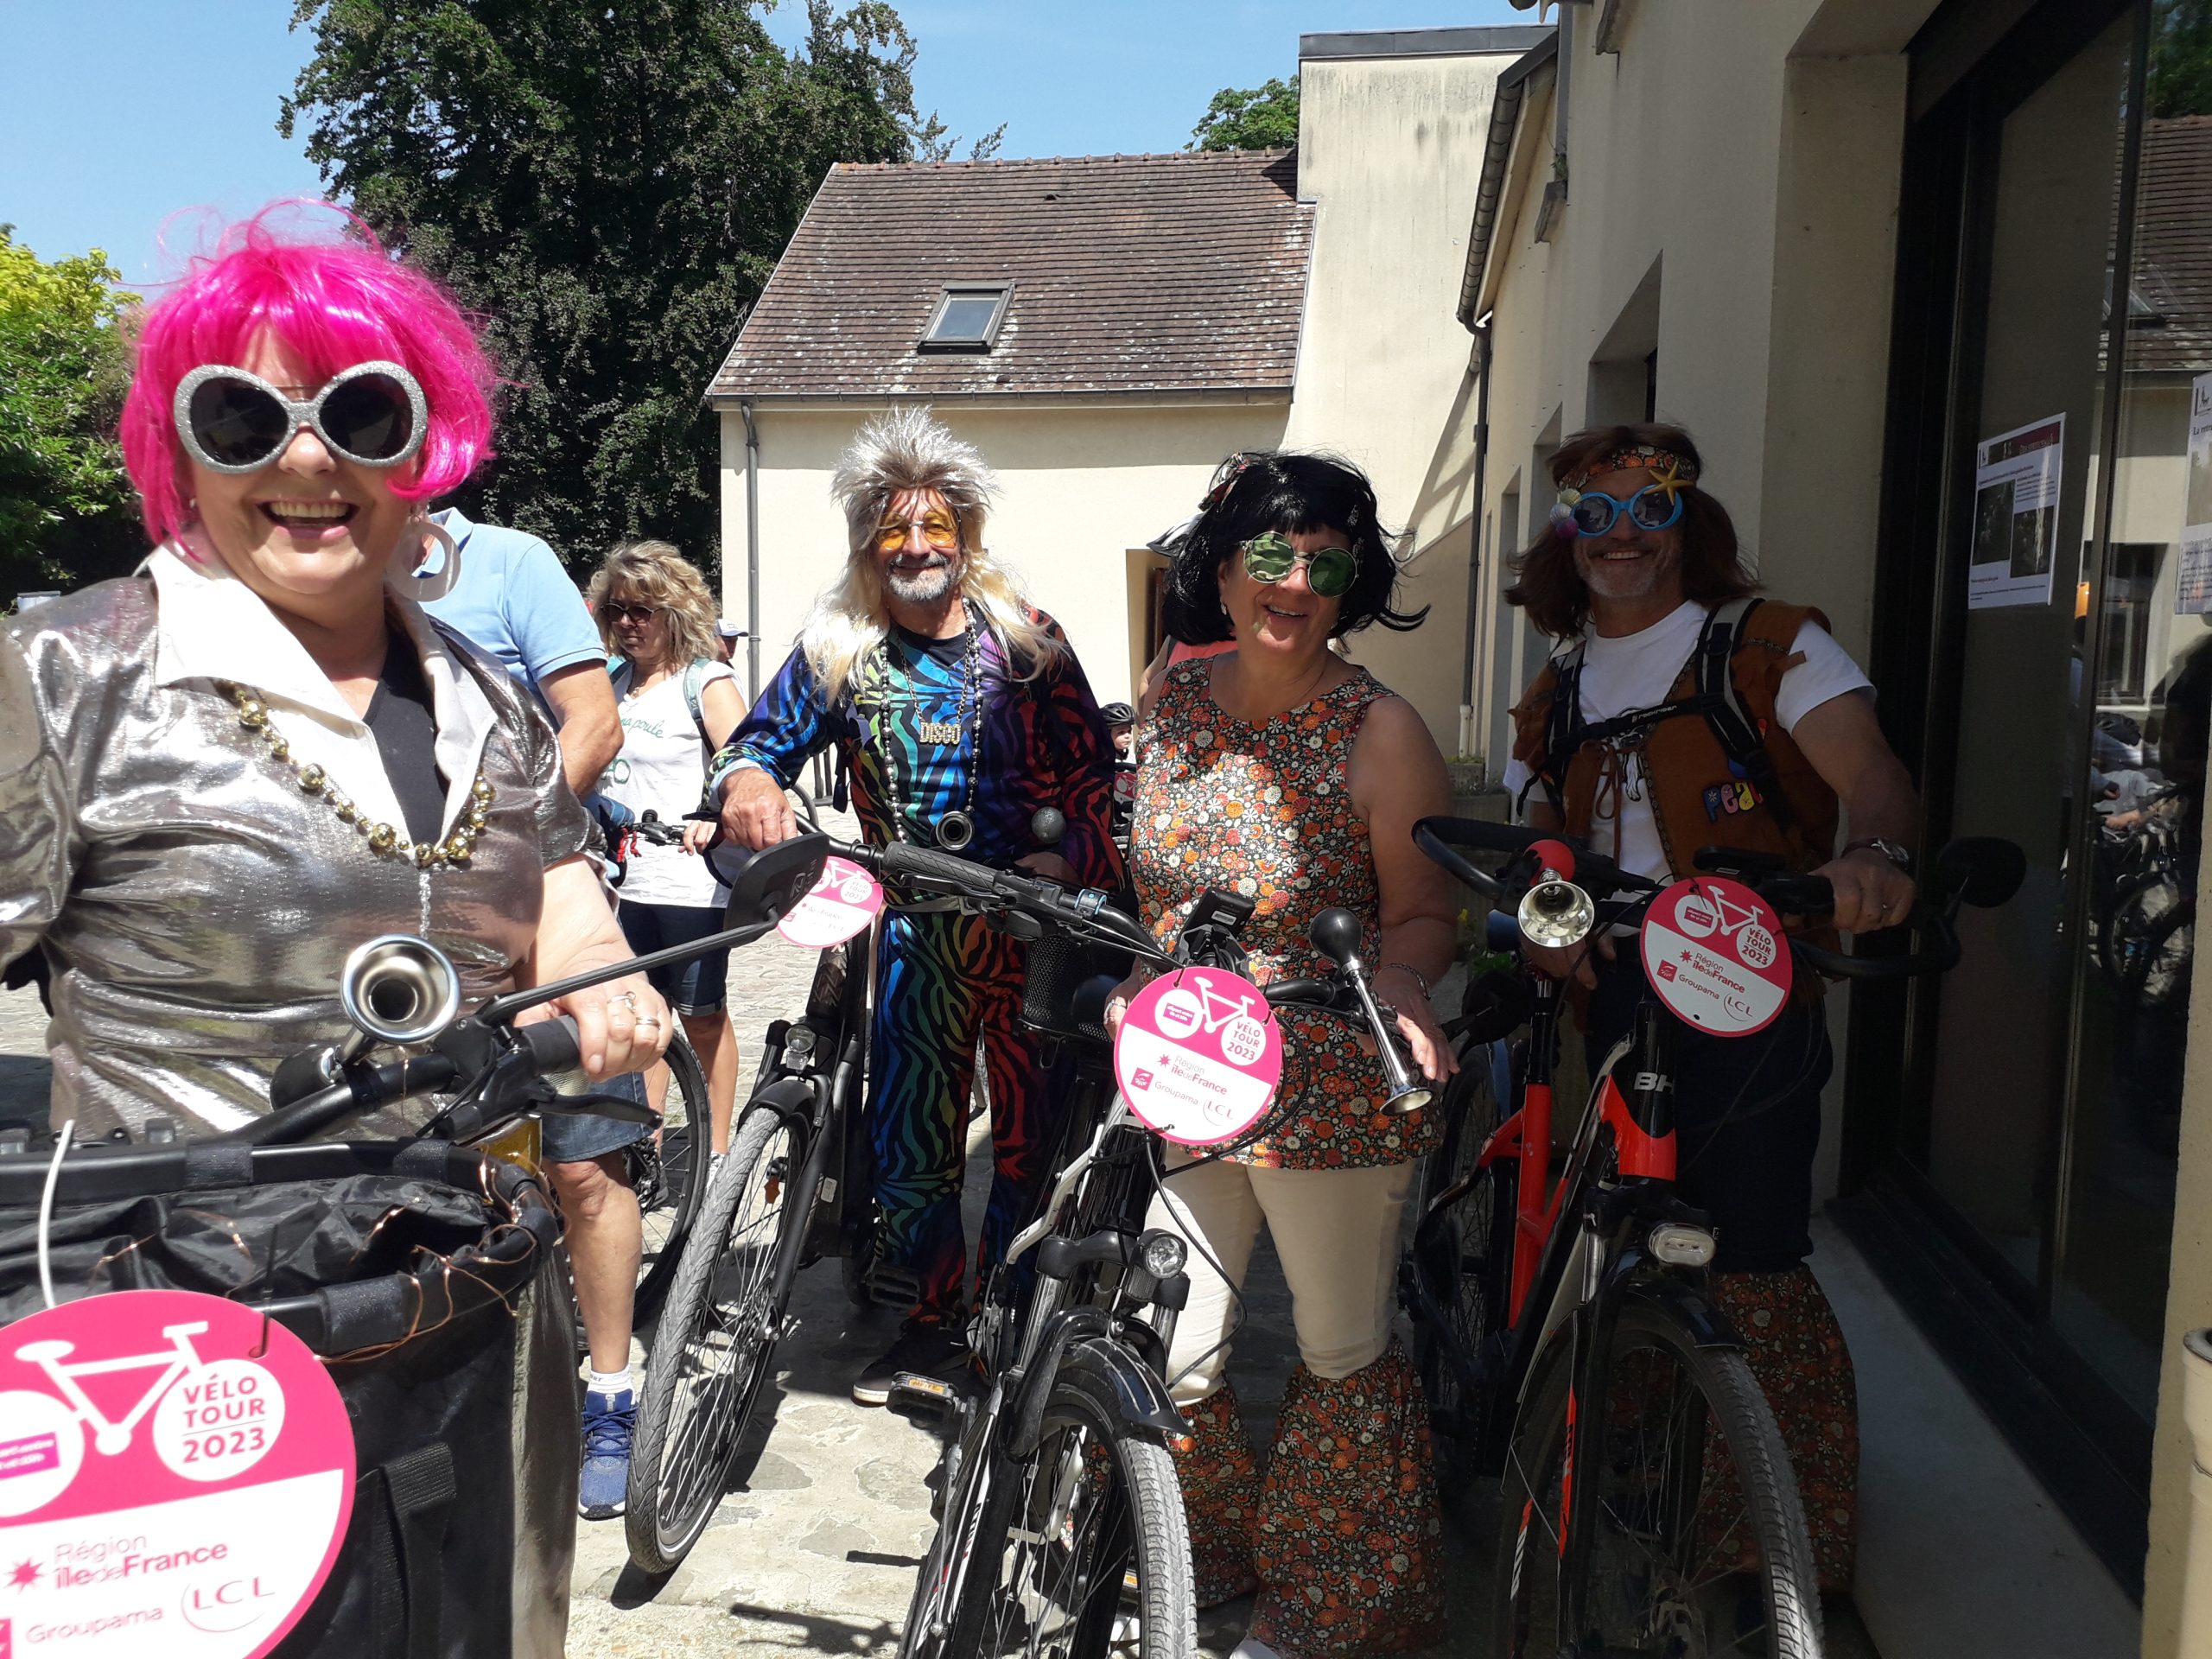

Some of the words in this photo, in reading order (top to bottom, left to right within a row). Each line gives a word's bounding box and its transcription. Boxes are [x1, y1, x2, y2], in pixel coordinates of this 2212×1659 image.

[919, 722, 962, 745] DISCO
[1745, 935, 1772, 956] TOUR
[1749, 927, 1771, 945] VÉLO
[1695, 952, 1724, 973] Région
[1741, 945, 1769, 965] 2023
[1678, 974, 1719, 1000] Groupama
[1727, 995, 1753, 1018] LCL
[1233, 1031, 1260, 1049] TOUR
[1236, 1021, 1261, 1038] VÉLO
[1227, 1042, 1255, 1061] 2023
[1174, 1055, 1205, 1075] Région
[1633, 1071, 1673, 1092] BH
[1154, 1081, 1199, 1106] Groupama
[1207, 1099, 1234, 1120] LCL
[183, 1373, 257, 1405] VÉLO
[183, 1397, 266, 1429] TOUR
[182, 1428, 265, 1464] 2023
[54, 1533, 148, 1565] Région
[26, 1606, 163, 1644] Groupama
[192, 1577, 276, 1611] LCL
